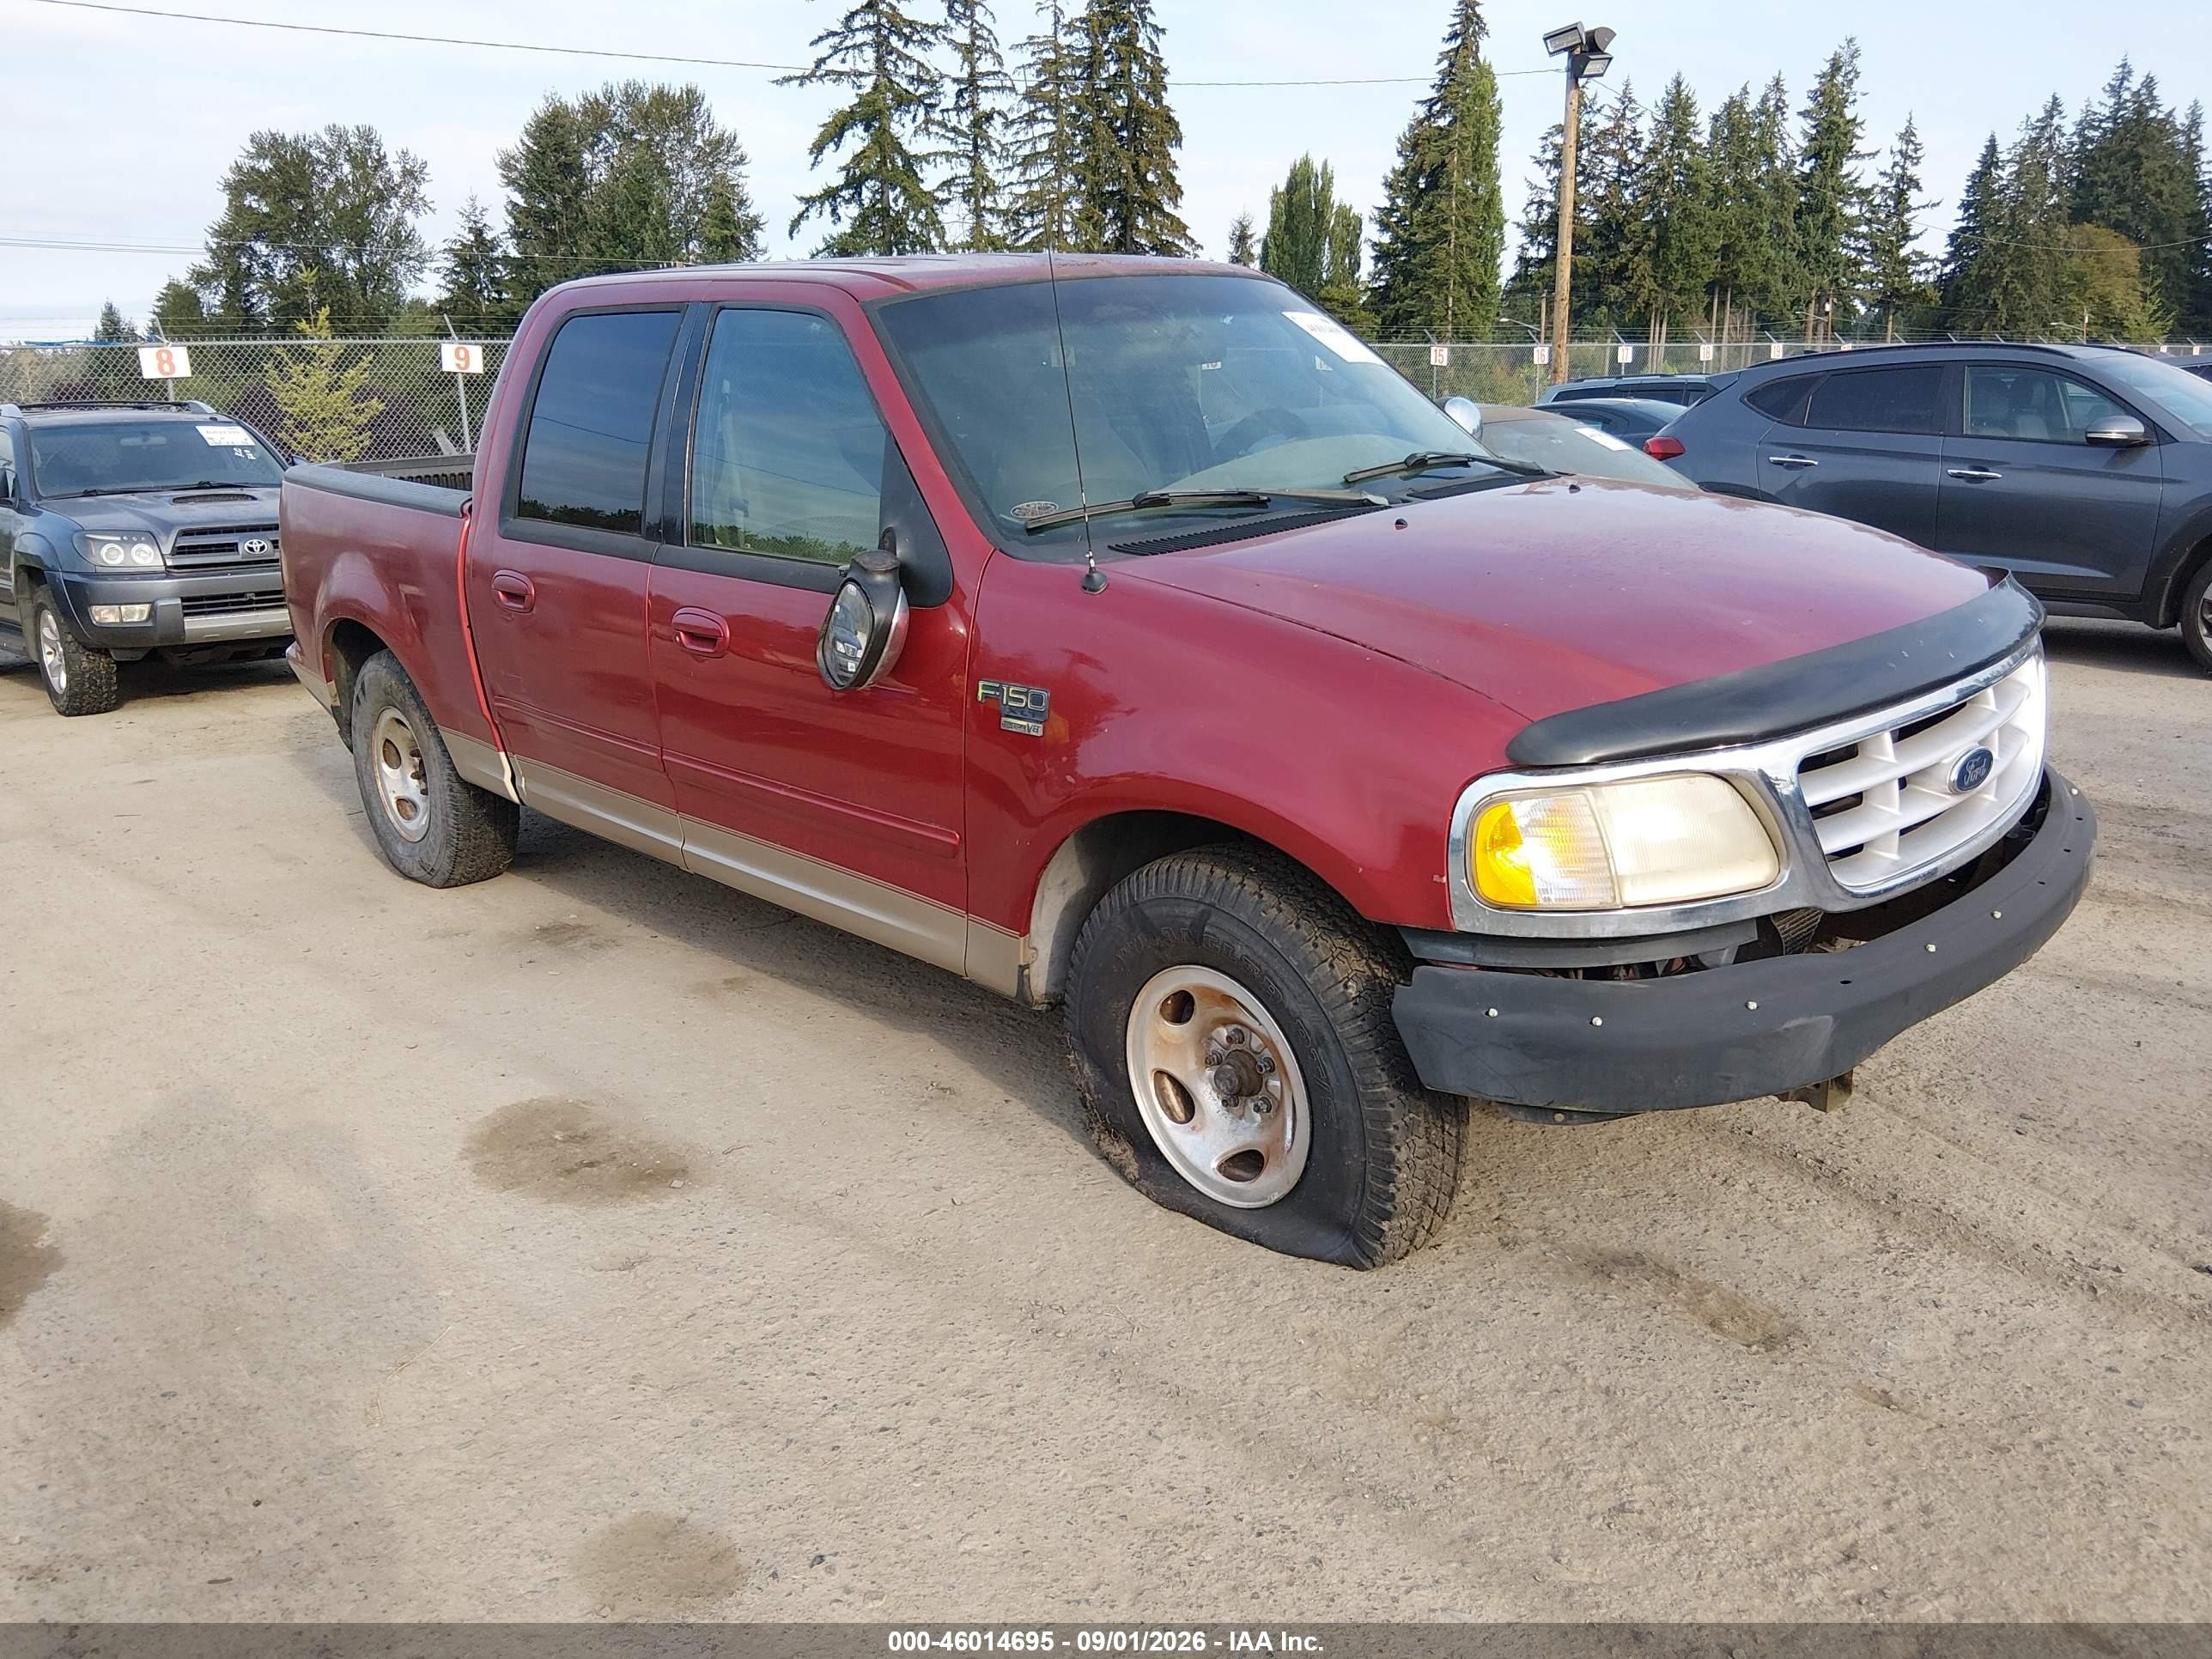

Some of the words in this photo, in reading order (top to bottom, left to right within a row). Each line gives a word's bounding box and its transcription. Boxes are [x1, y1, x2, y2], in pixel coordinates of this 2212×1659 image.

[454, 346, 471, 371] 9
[1433, 348, 1445, 365] 15
[1535, 348, 1546, 363] 16
[1620, 347, 1630, 362] 17
[1702, 346, 1711, 360] 18
[1772, 344, 1781, 358] 19
[155, 349, 176, 376] 8
[1963, 755, 1987, 787] Ford
